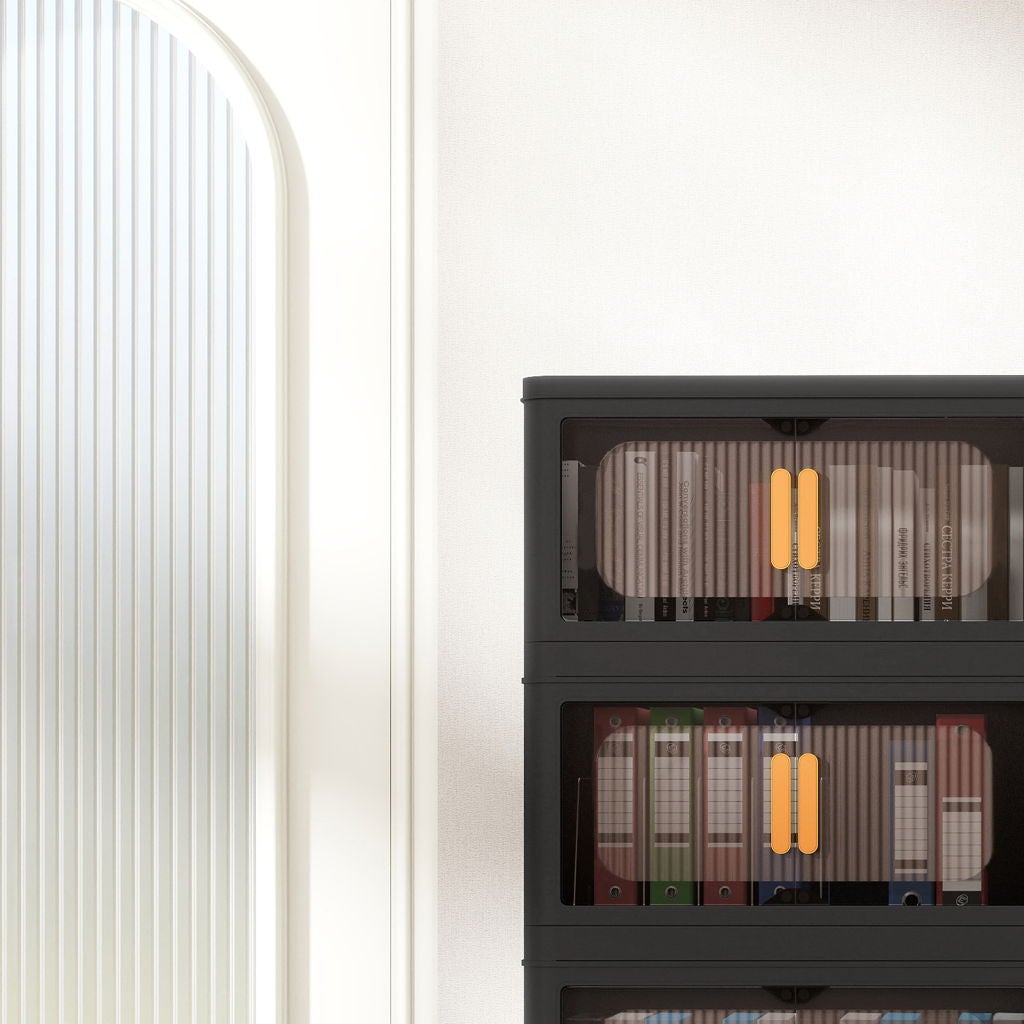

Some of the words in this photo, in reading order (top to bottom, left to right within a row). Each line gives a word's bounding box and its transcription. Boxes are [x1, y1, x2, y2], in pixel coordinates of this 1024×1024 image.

[942, 525, 953, 571] СЕСТРА
[810, 573, 821, 610] КЕРРИ
[942, 573, 953, 610] КЕРРИ
